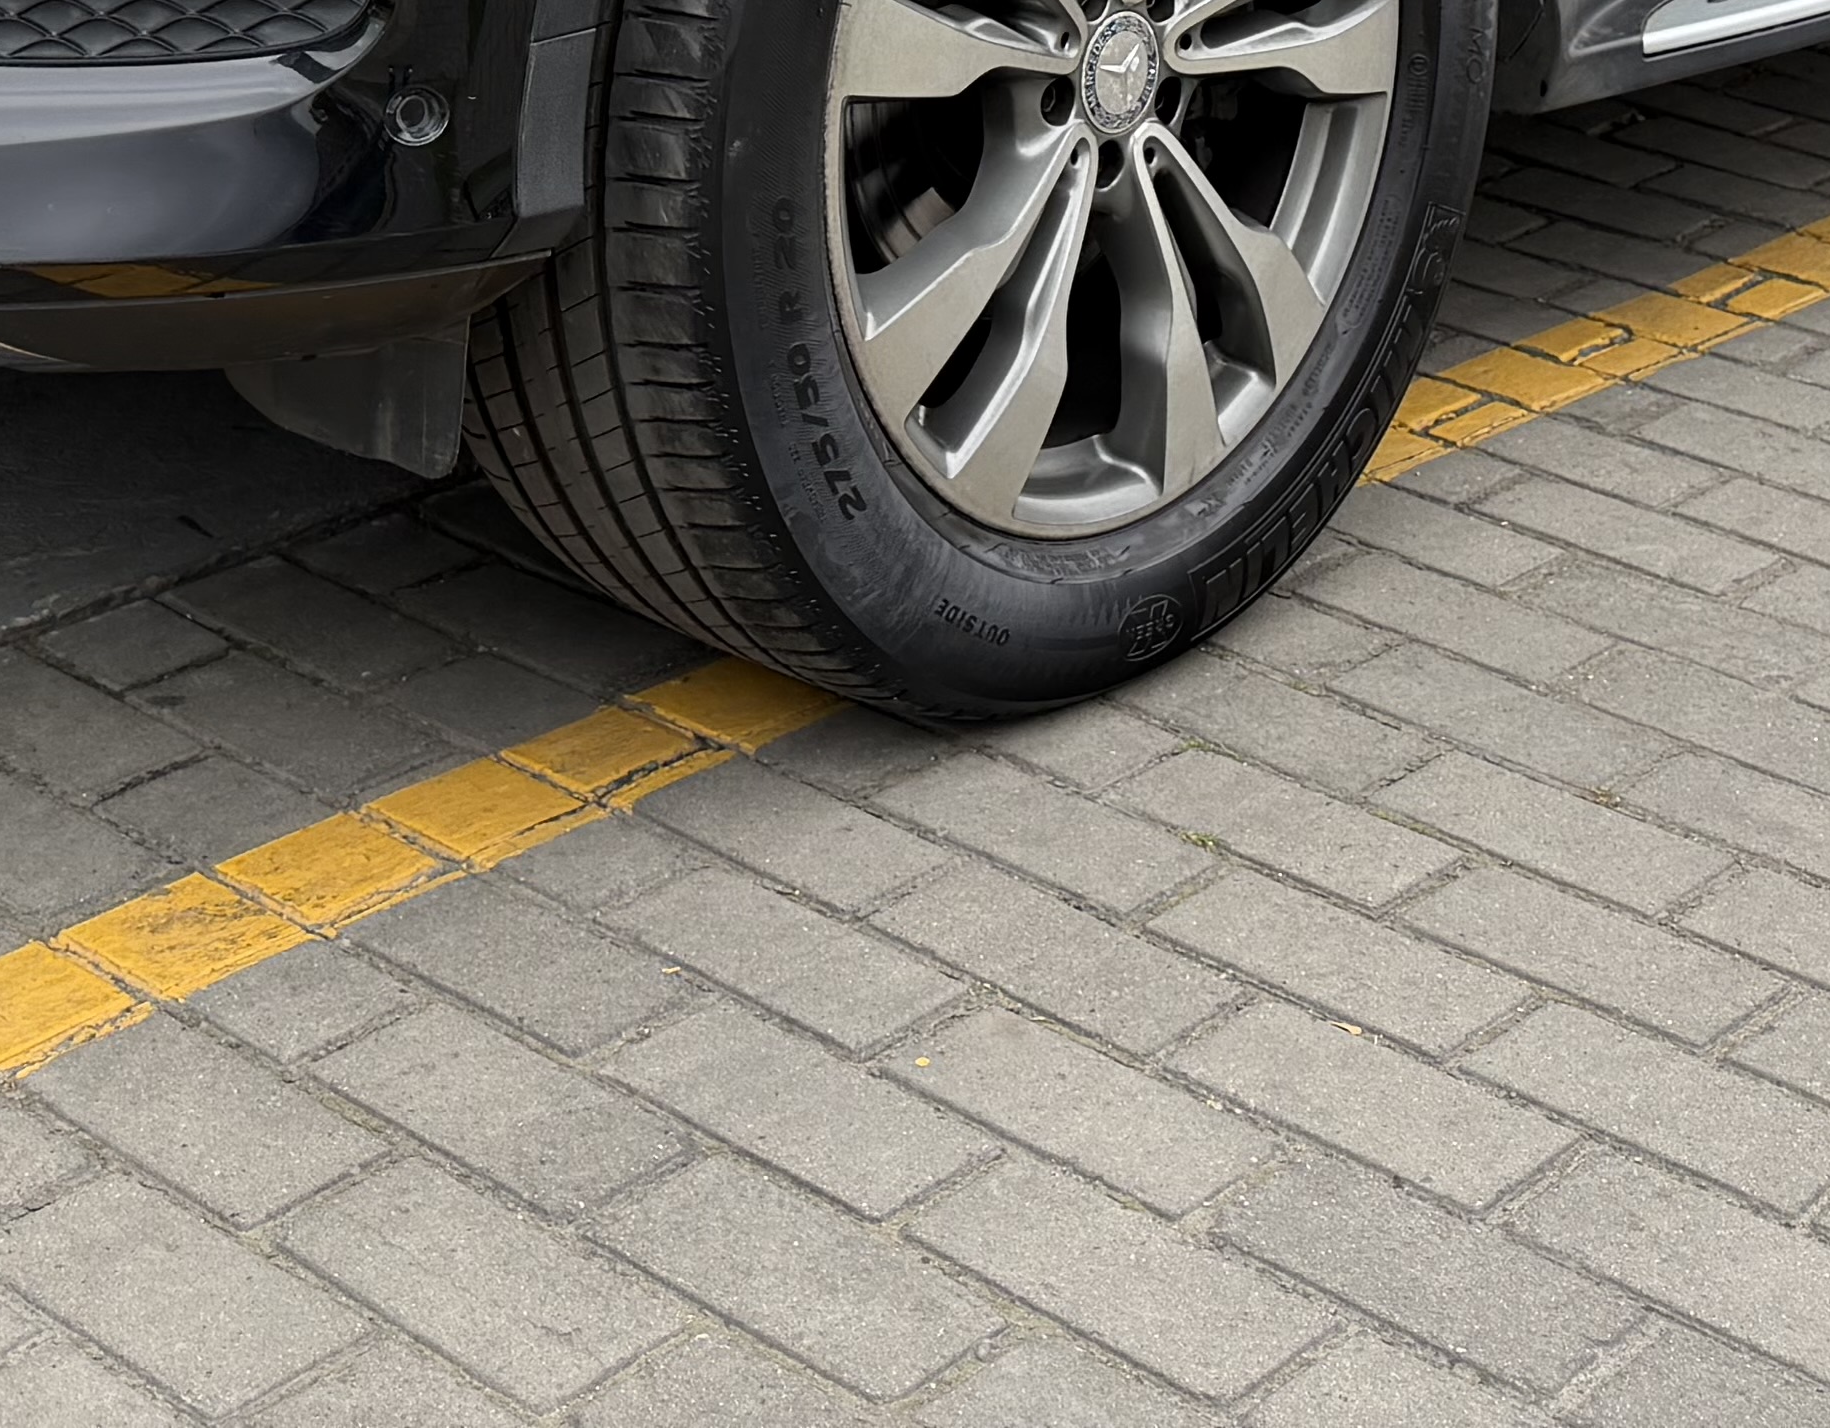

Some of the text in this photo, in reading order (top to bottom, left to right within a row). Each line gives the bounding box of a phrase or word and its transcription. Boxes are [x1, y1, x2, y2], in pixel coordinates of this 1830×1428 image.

[778, 289, 804, 326] R
[786, 342, 868, 521] 275/50
[1202, 302, 1424, 624] MICHELIN
[934, 597, 1010, 647] OUTSIDE
